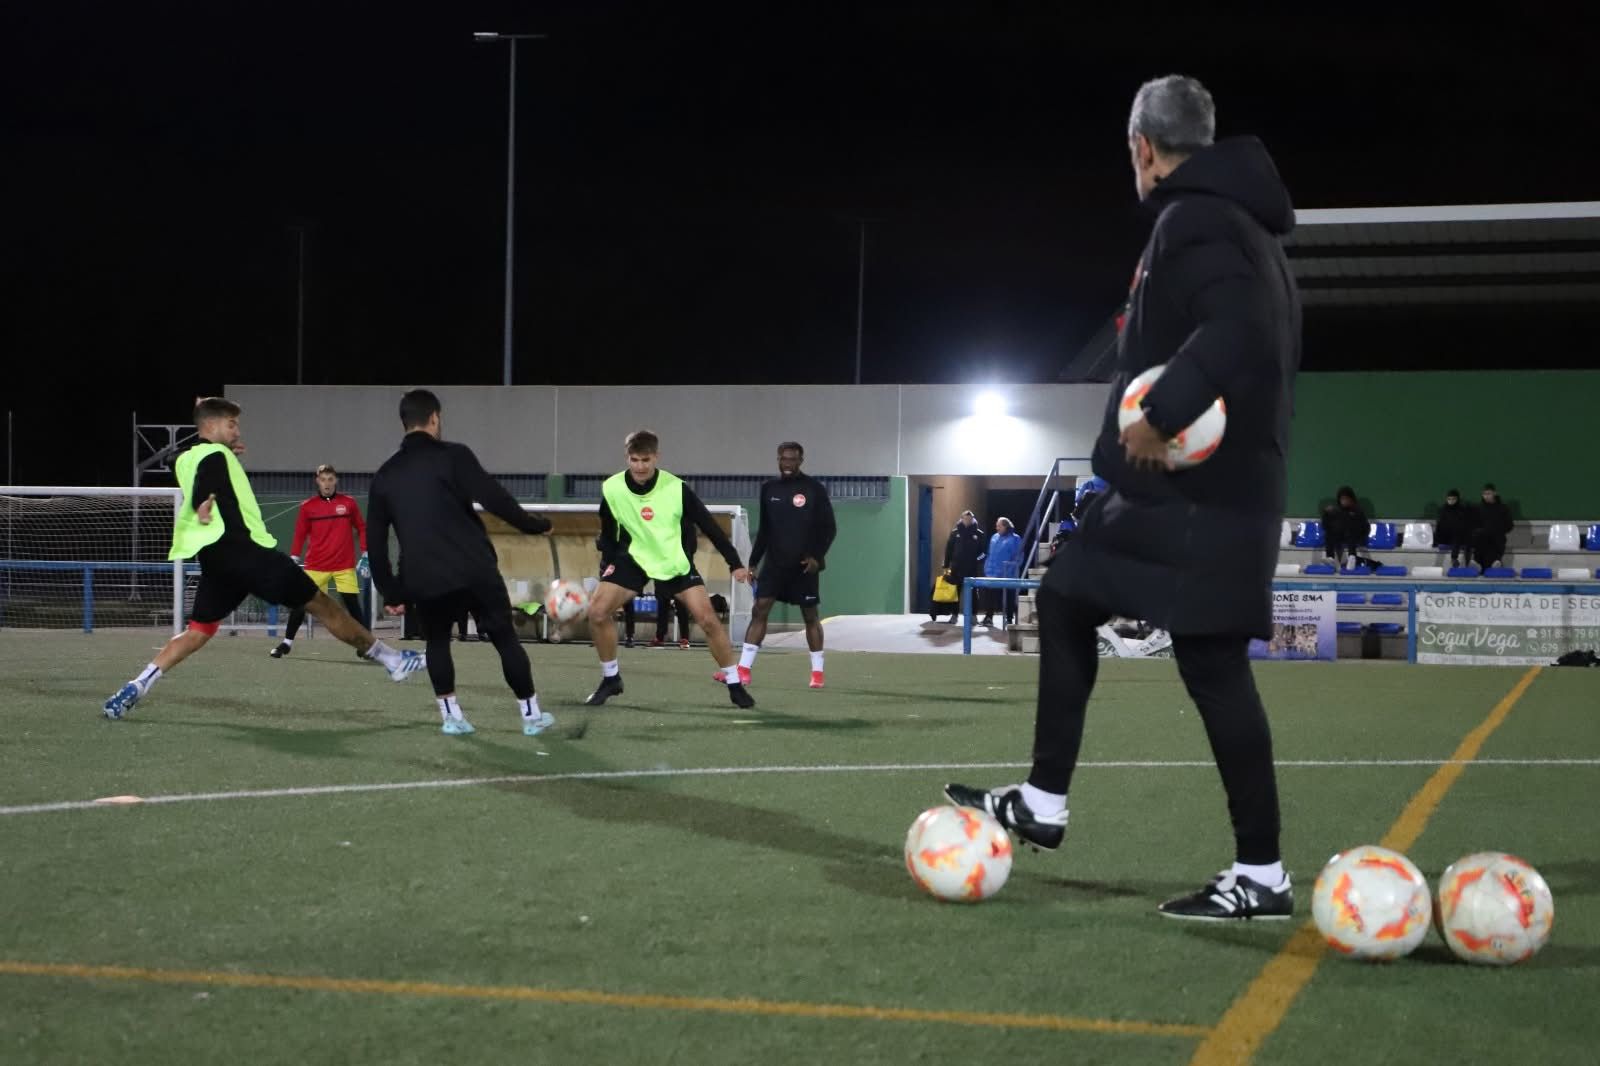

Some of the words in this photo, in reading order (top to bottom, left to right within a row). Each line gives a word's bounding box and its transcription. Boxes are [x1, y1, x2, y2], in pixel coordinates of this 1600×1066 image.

[1302, 594, 1323, 602] SMA
[1540, 597, 1561, 610] DE
[1421, 624, 1521, 655] SegurVega
[1540, 628, 1551, 640] 91
